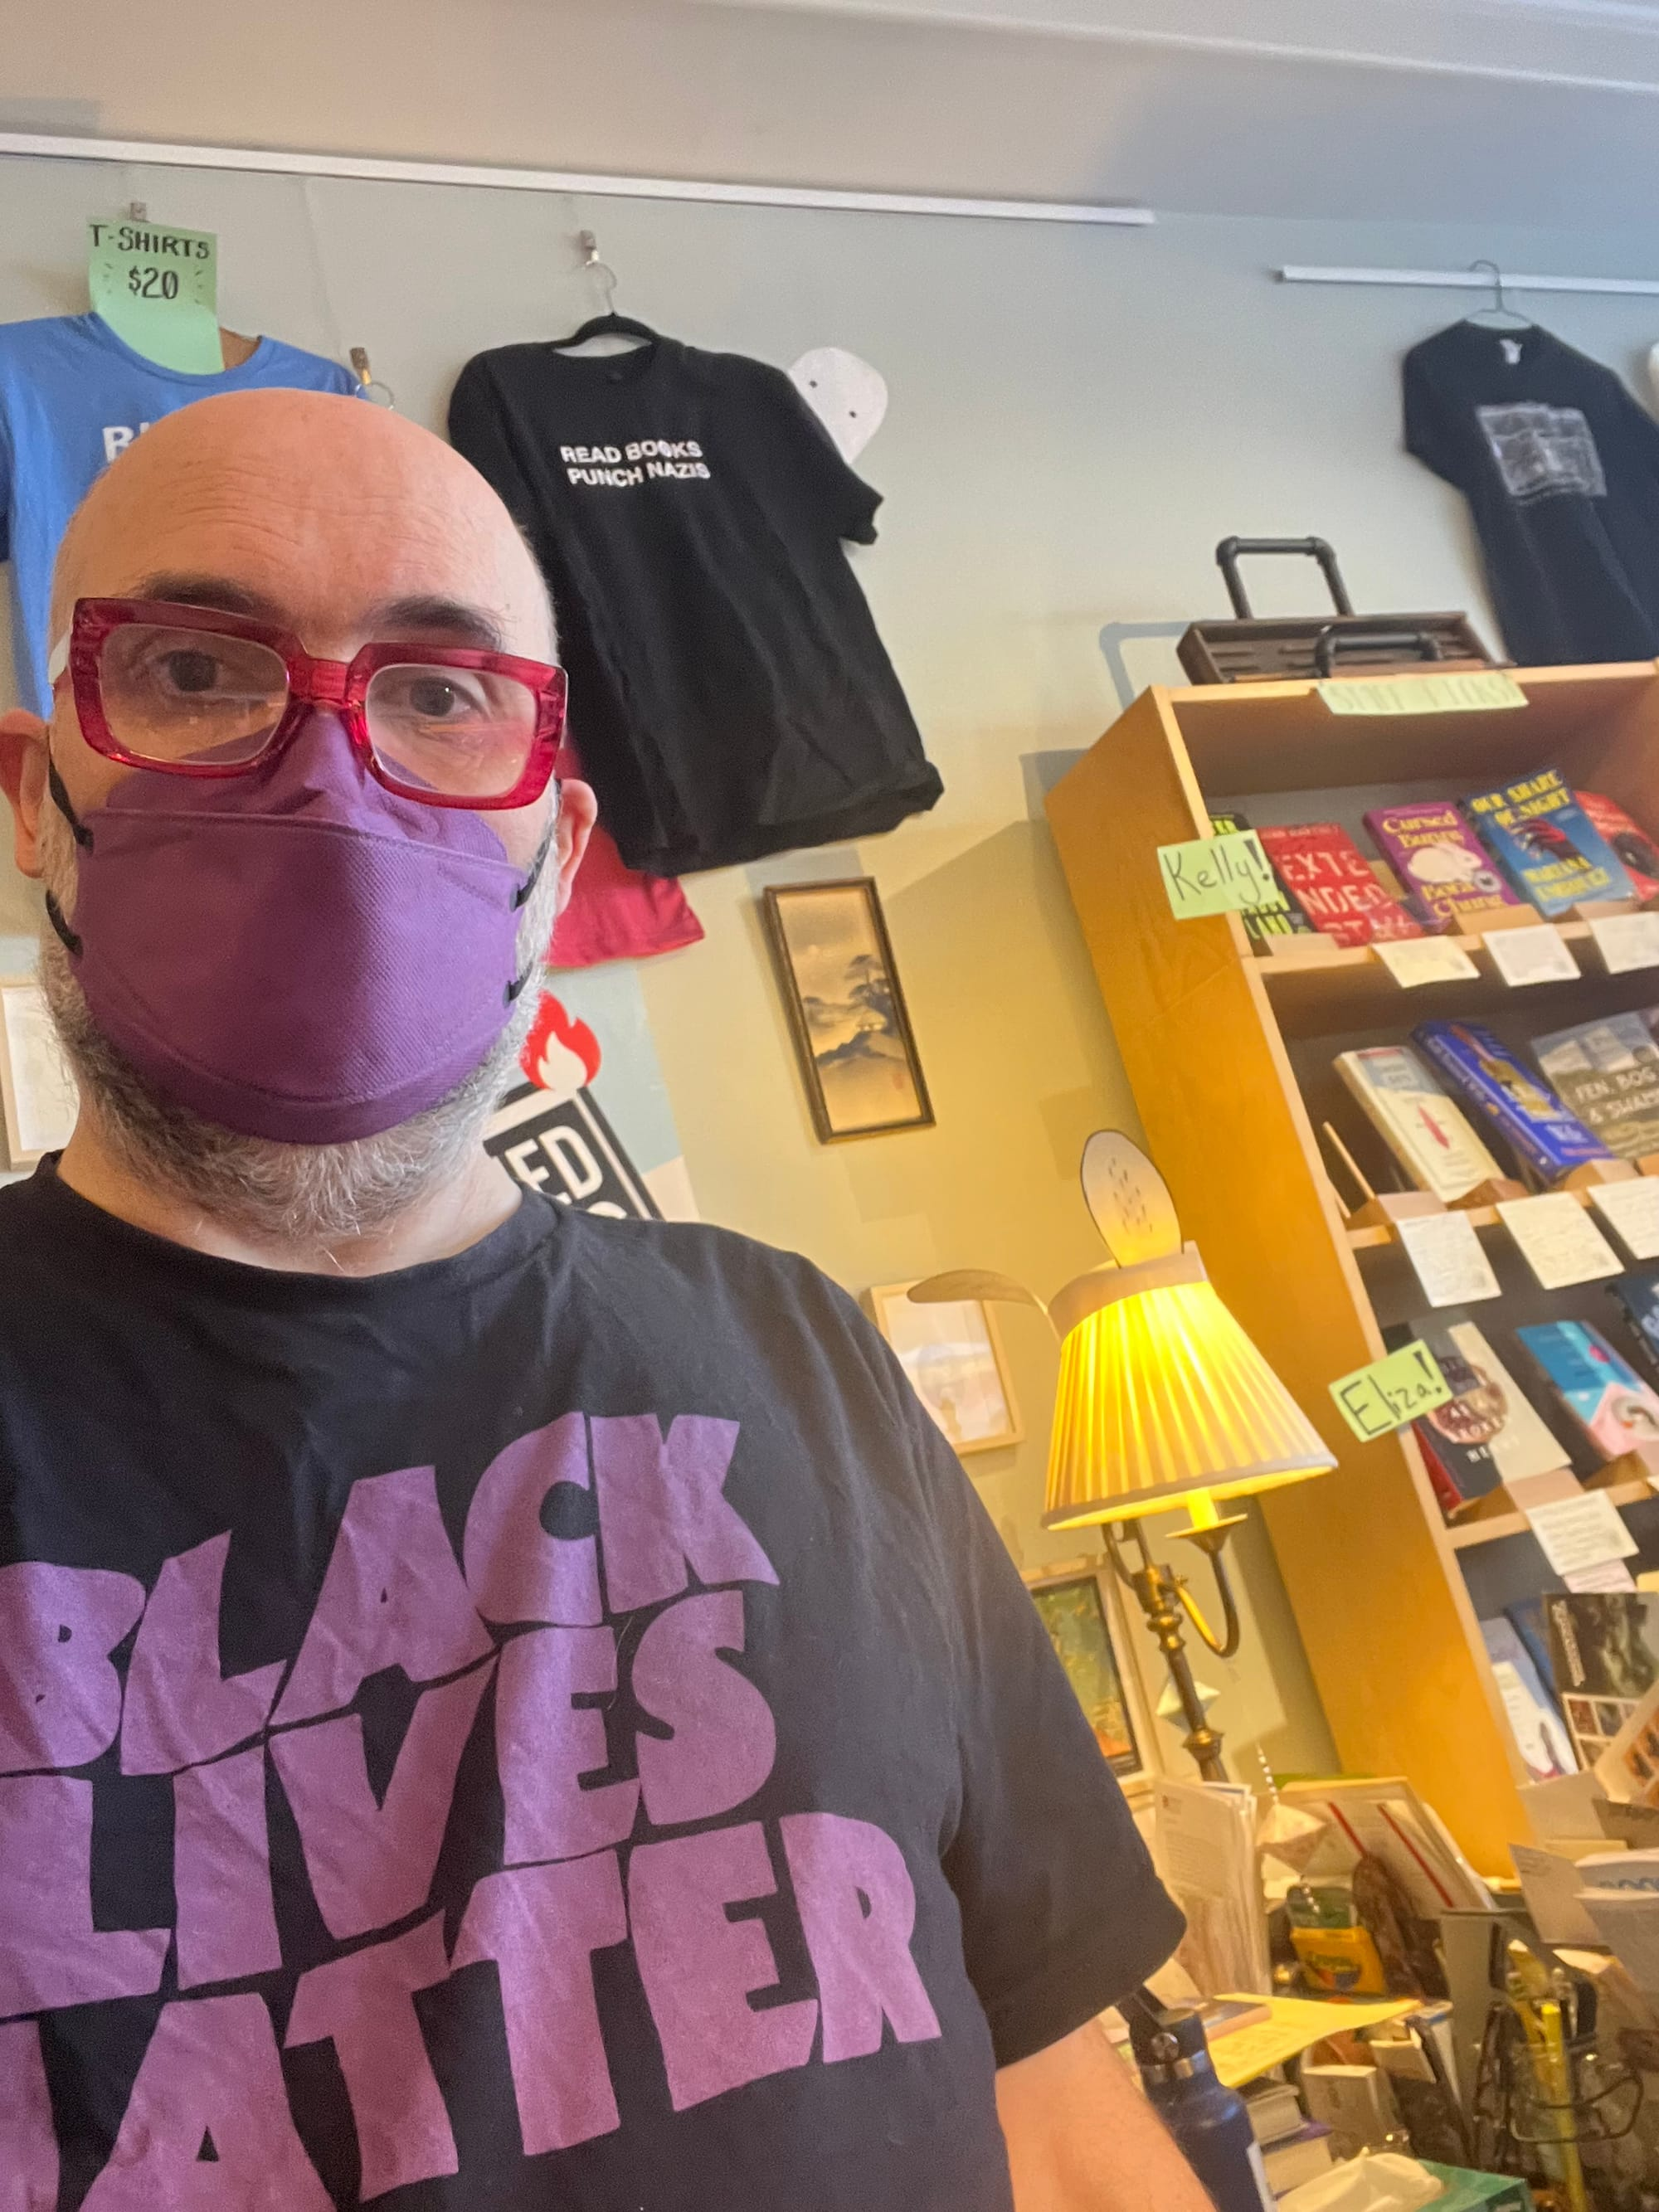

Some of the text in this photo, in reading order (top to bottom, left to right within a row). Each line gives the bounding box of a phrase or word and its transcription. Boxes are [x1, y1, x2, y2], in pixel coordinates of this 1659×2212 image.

[89, 223, 210, 260] T-SHIRTS
[128, 265, 179, 300] $20
[560, 440, 703, 464] READ BOOKS
[567, 461, 711, 488] PUNCH NAZIS
[1163, 838, 1272, 905] Kelly!
[1338, 1351, 1443, 1436] Eliza!
[0, 1411, 781, 1775] BLACK
[0, 1589, 778, 2020] LIVES
